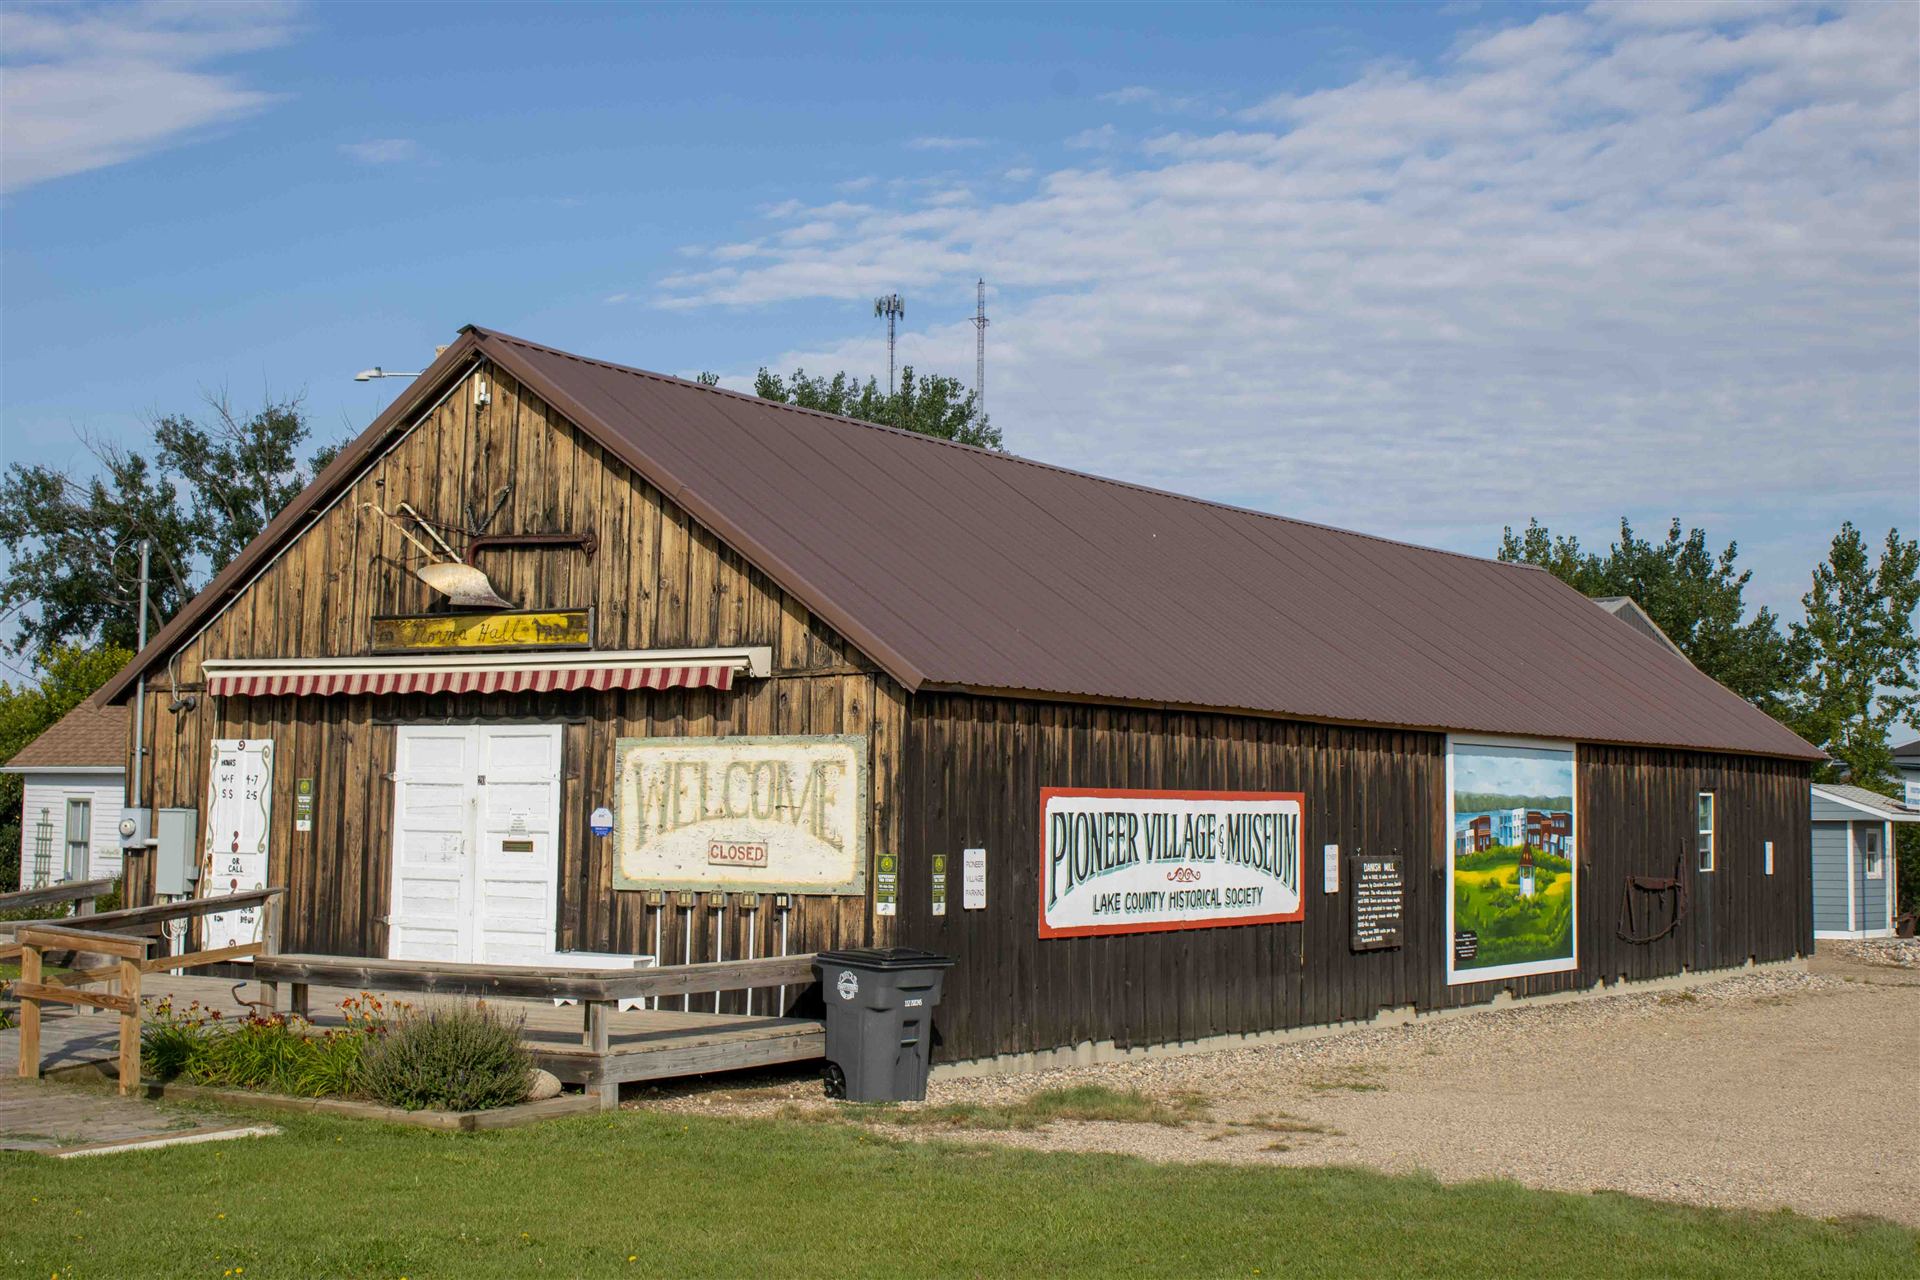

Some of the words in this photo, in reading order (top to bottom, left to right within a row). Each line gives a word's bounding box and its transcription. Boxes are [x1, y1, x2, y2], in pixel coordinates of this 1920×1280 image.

[478, 619, 524, 643] Hall
[221, 759, 236, 767] HOURS
[632, 760, 846, 853] WELCOME
[231, 857, 240, 865] OR
[709, 843, 765, 862] CLOSED
[1049, 812, 1140, 911] PIONEER
[1142, 812, 1216, 862] VILLAGE
[1226, 813, 1297, 895] MUSEUM
[228, 864, 244, 873] CALL
[1093, 892, 1121, 914] LAKE
[1124, 890, 1165, 913] COUNTY
[1168, 886, 1222, 911] HISTORICAL
[1224, 885, 1264, 908] SOCIETY
